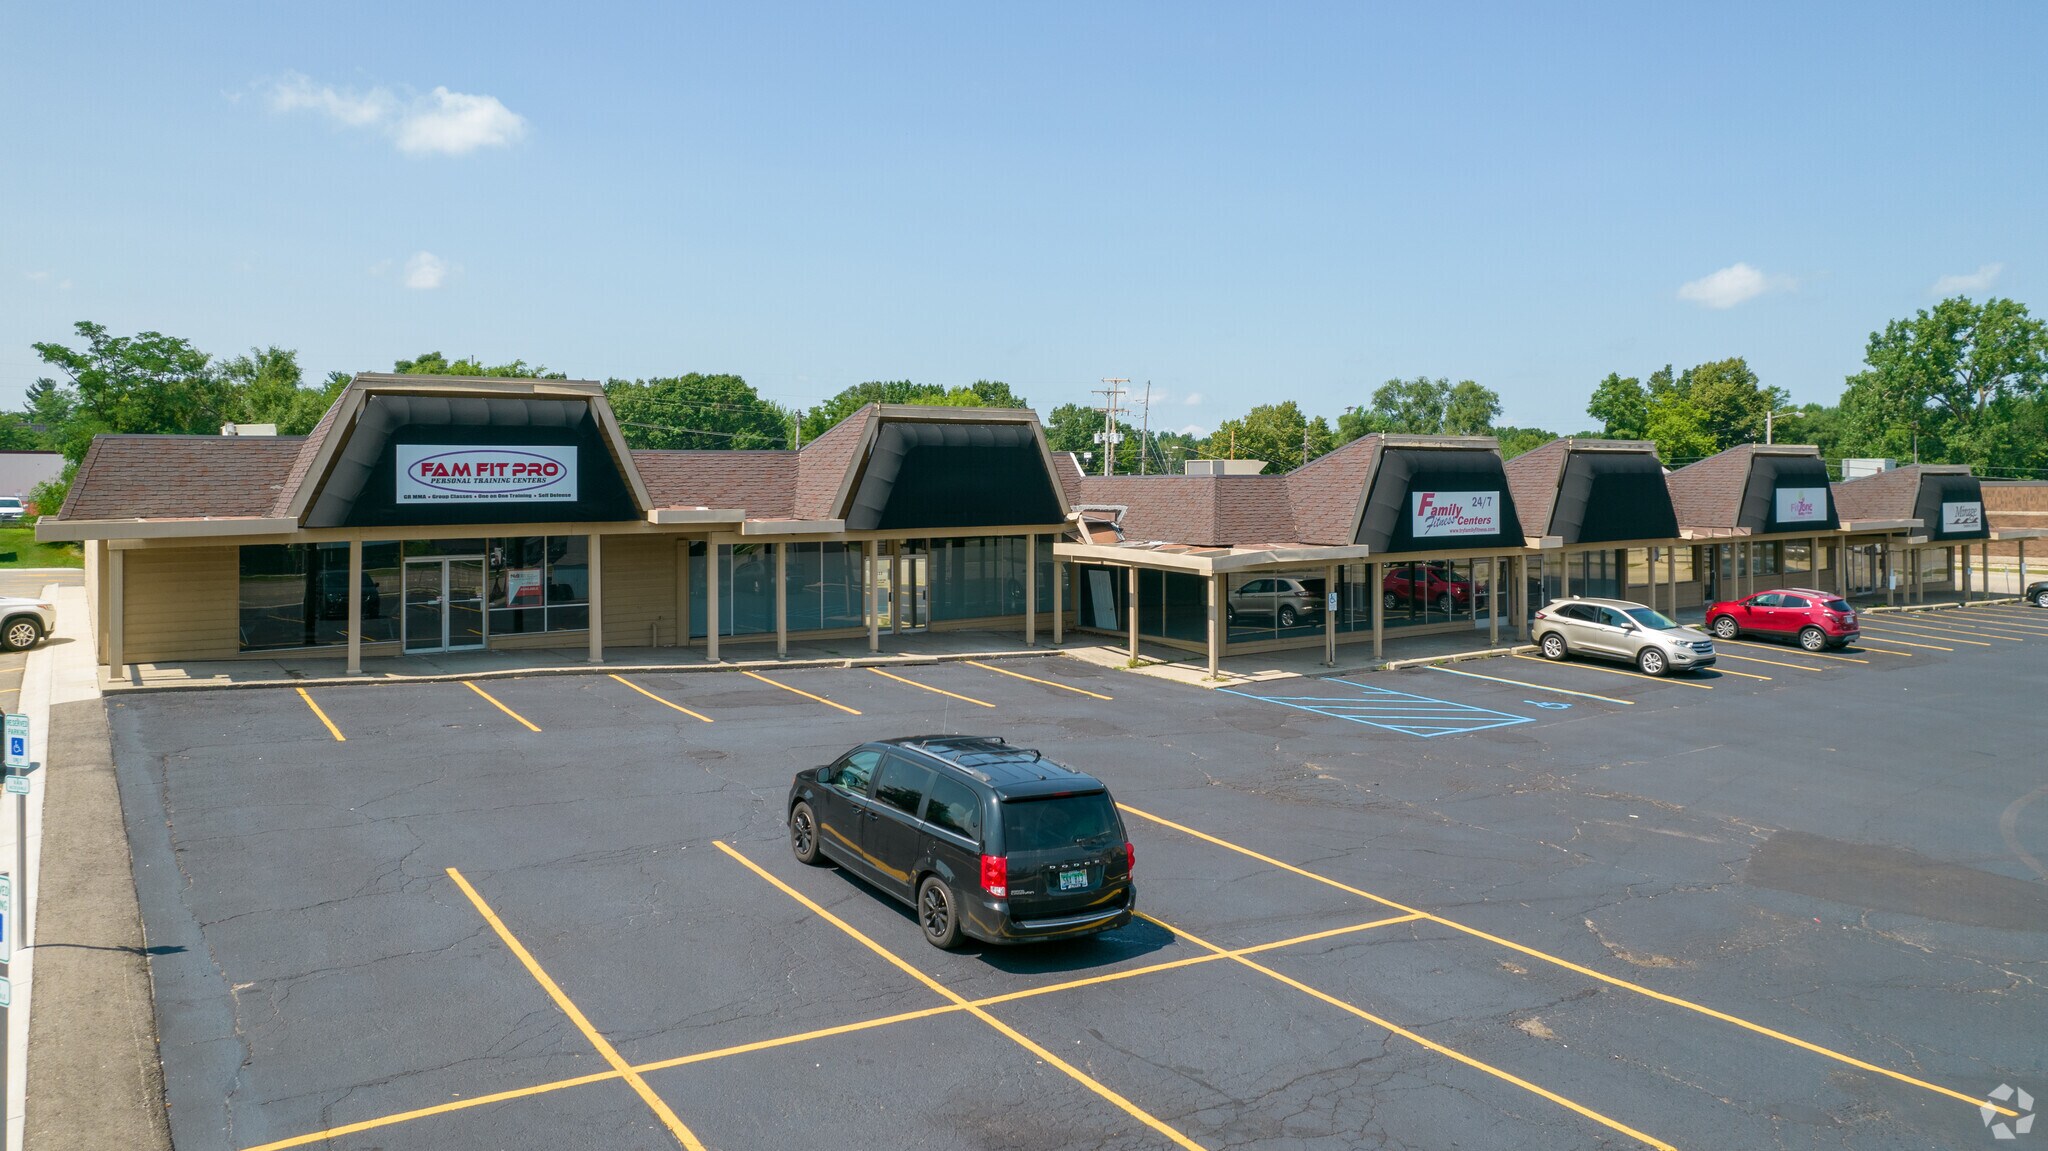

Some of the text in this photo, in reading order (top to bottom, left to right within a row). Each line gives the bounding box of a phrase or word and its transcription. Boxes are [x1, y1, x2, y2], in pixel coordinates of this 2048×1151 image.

[421, 462, 559, 477] FAM FIT PRO
[1417, 493, 1463, 518] Family
[1472, 496, 1492, 509] 24/7
[1424, 515, 1492, 535] Fitness Centers
